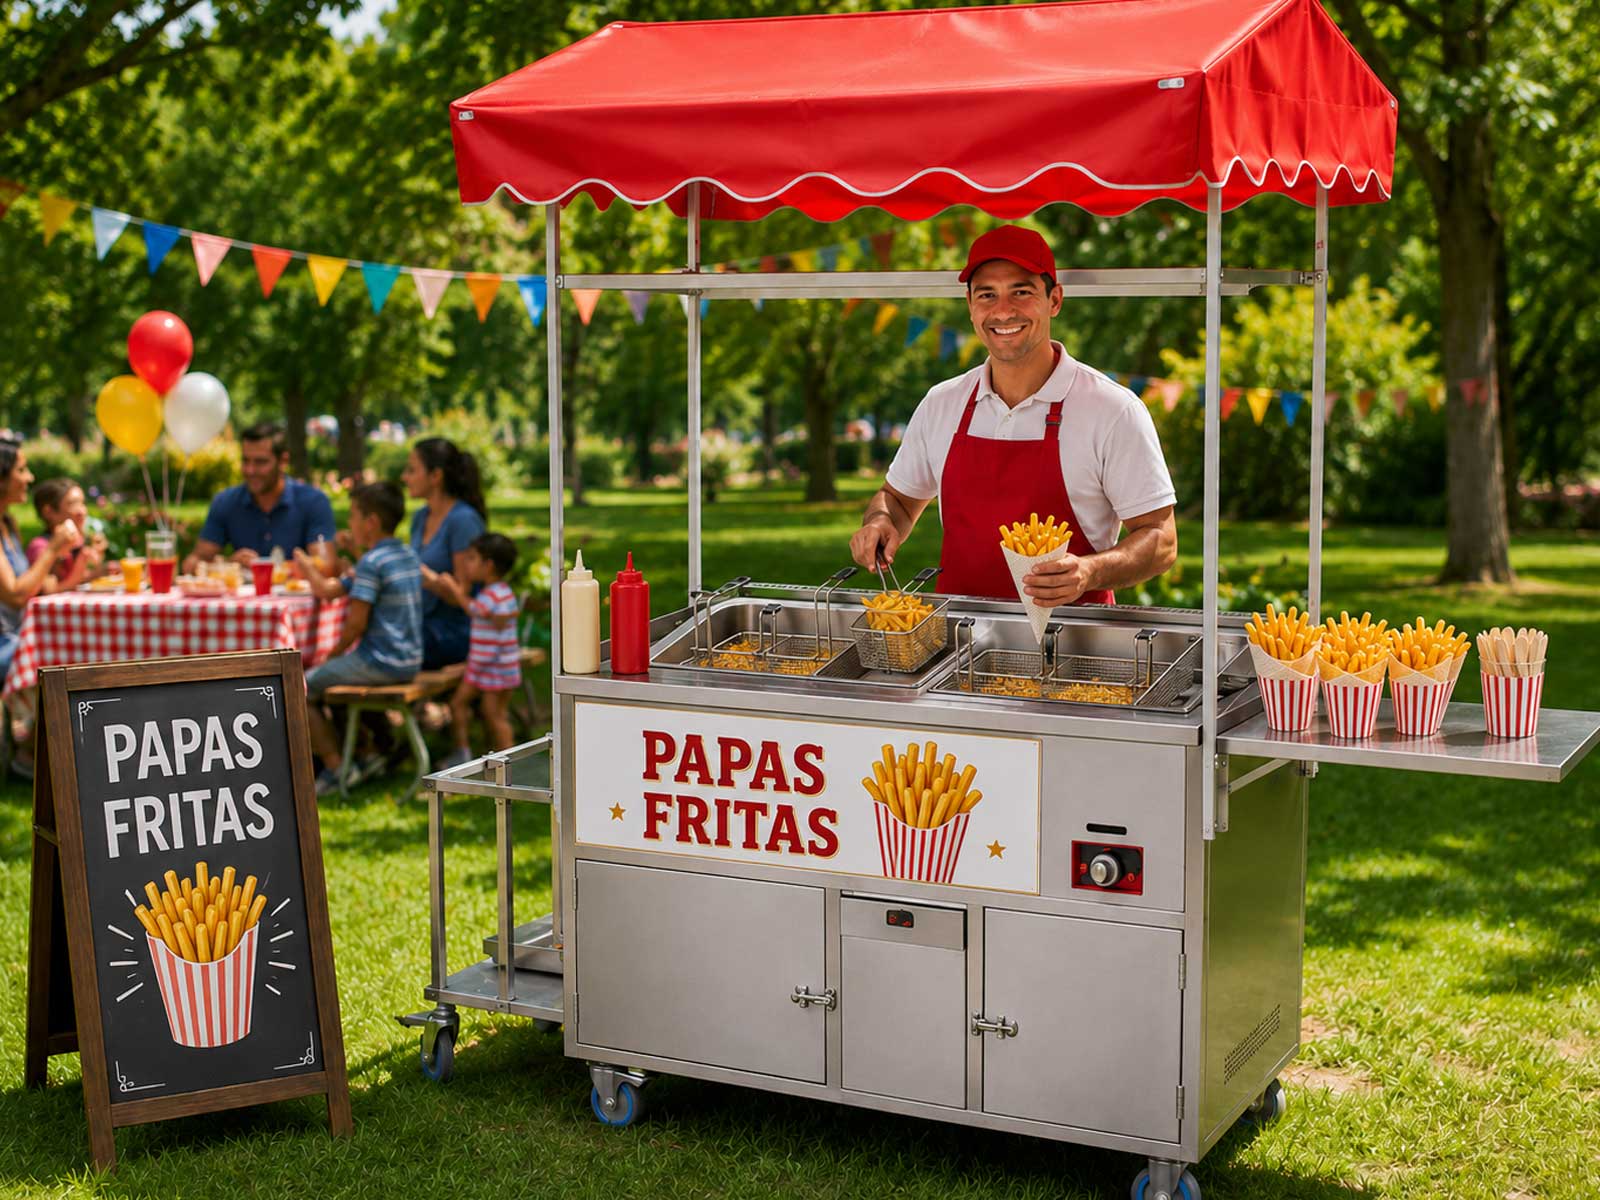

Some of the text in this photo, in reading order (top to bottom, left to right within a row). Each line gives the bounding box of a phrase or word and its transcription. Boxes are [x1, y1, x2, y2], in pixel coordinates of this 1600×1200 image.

[103, 712, 263, 783] PAPAS
[642, 730, 826, 796] PAPAS
[103, 782, 275, 859] FRITAS
[642, 791, 840, 859] FRITAS
